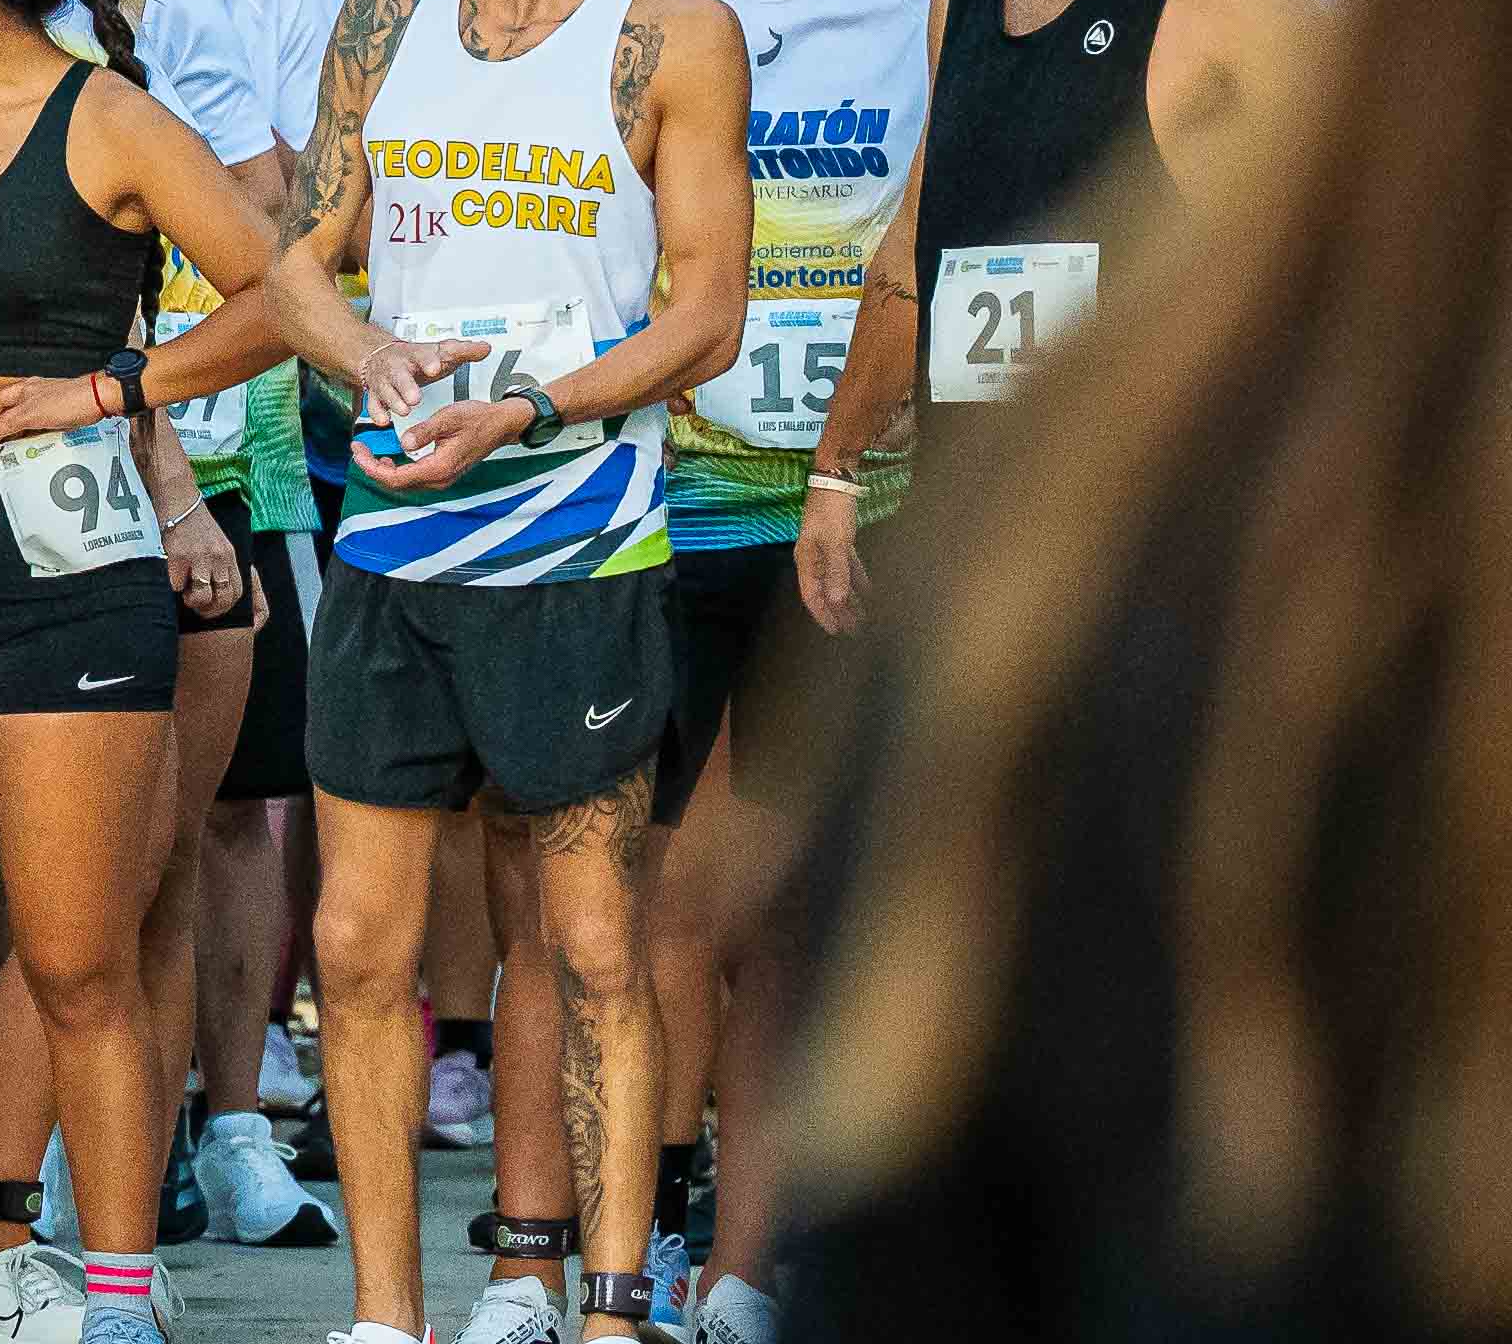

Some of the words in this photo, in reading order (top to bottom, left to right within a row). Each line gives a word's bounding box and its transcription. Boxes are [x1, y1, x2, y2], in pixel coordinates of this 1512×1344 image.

[748, 100, 891, 147] RATÓN
[368, 140, 616, 195] TEODELINA
[451, 190, 600, 237] CORRE
[966, 291, 1035, 366] 21
[749, 343, 848, 414] 15
[48, 457, 143, 535] 94
